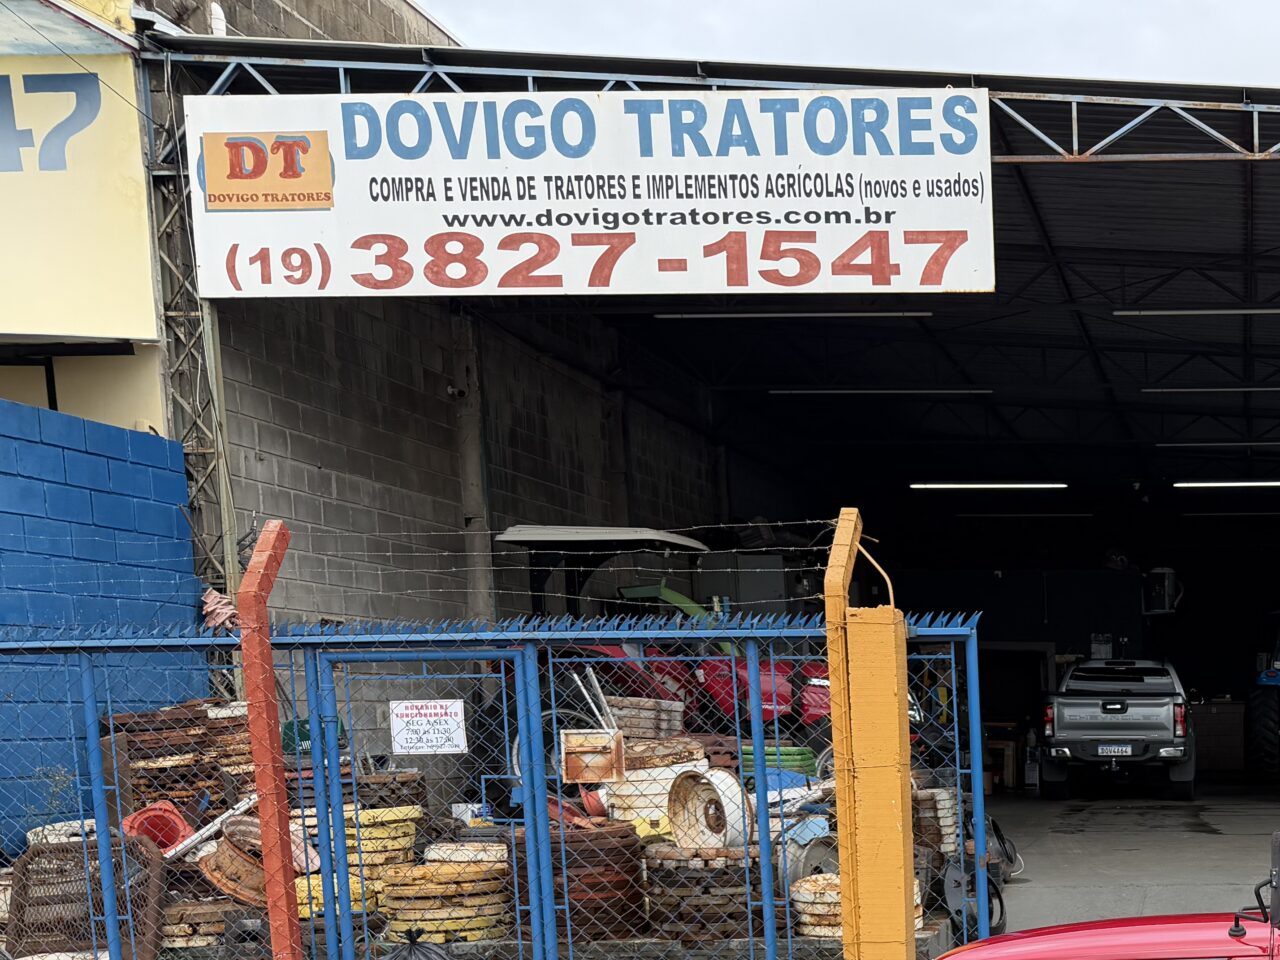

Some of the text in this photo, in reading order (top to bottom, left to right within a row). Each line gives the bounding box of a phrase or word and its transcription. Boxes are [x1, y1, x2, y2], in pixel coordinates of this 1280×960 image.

[341, 94, 979, 161] DOVIGO TRATORES
[224, 135, 311, 180] DT
[208, 191, 333, 204] DOVIGO TRATORES
[369, 165, 985, 205] COMPRA E VENDA DE TRATORES E IMPLEMENTOS AGRÍCOLAS (novos e usados)
[442, 206, 897, 231] www.dovigotratores.com.br
[225, 243, 332, 291] (19)
